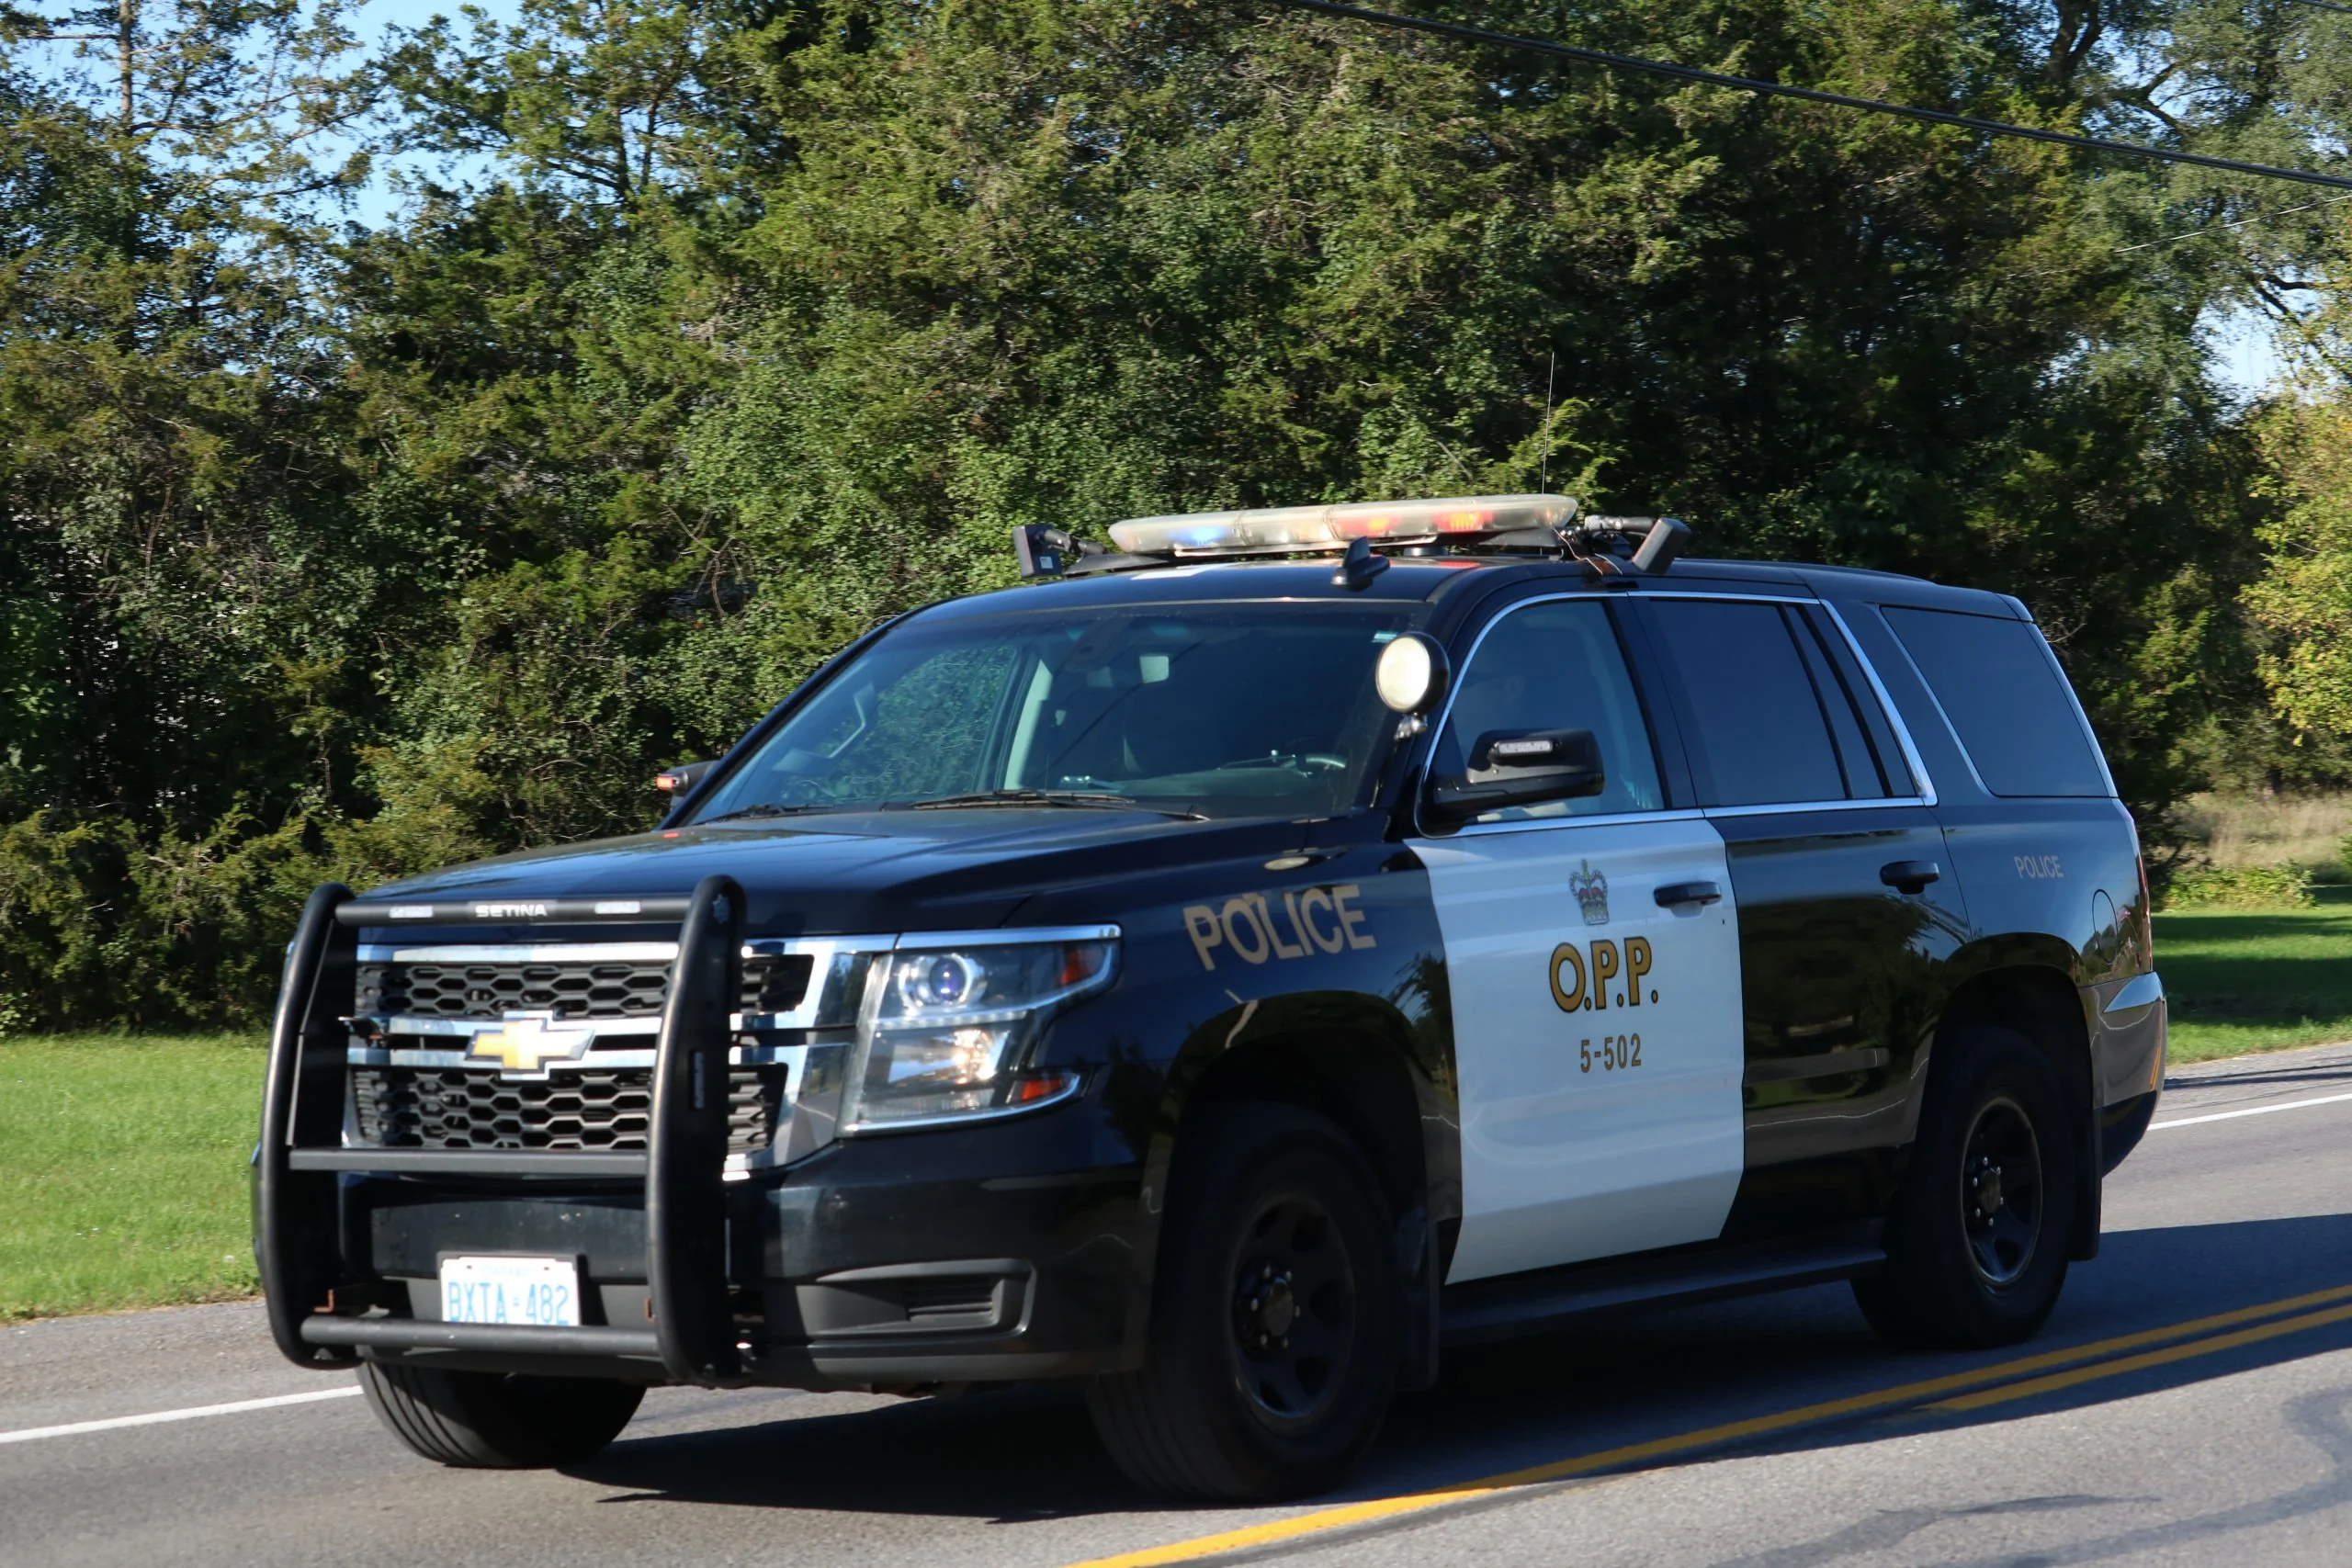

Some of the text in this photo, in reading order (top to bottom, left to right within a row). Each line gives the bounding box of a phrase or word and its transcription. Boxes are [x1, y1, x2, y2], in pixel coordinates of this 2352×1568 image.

[2013, 855, 2064, 879] POLICE
[475, 903, 548, 918] SETINA
[1182, 885, 1377, 972] POLICE
[1549, 936, 1659, 1013] O.P.P.
[1580, 1032, 1642, 1073] 5-502
